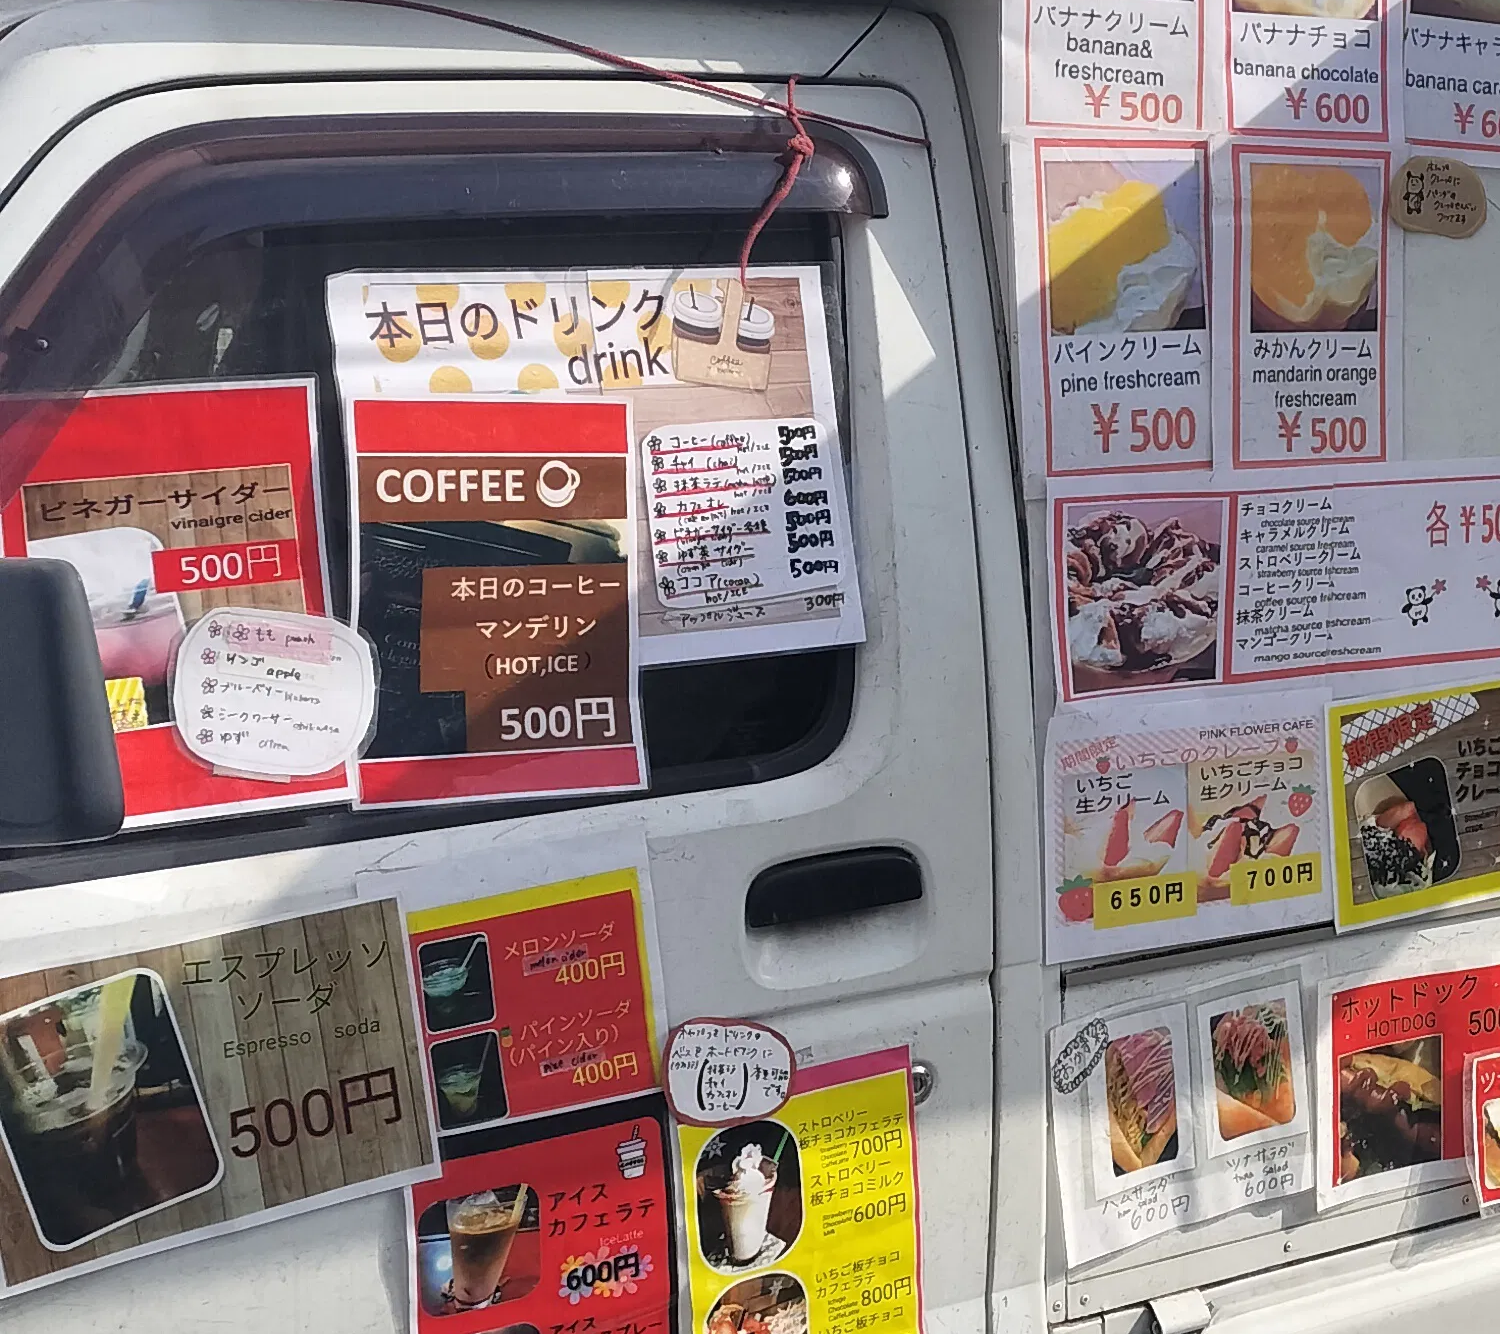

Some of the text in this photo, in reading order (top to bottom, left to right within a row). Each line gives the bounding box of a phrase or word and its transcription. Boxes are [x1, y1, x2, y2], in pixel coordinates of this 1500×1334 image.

[1034, 4, 1189, 38] バナナクリーム
[1067, 32, 1153, 59] banana&
[1240, 22, 1372, 50] バナナチョコ
[1055, 60, 1164, 88] freshcream
[1233, 59, 1379, 85] banana chocolate
[1406, 68, 1468, 94] banana
[365, 289, 668, 348] 本日のドリンク
[568, 338, 670, 385] drink
[1054, 336, 1201, 365] パインクリーム
[1254, 338, 1372, 360] みかんクリーム
[1061, 368, 1200, 397] pine freshcream
[1253, 365, 1377, 386] mandarin orange
[1275, 390, 1357, 407] freshcream
[376, 468, 525, 504] COFFEE
[40, 481, 290, 524] ビネガーサイダー
[249, 505, 294, 524] cider
[1241, 497, 1332, 517] チョコクリーム
[1240, 521, 1350, 543] キャラメルクリーム
[1261, 517, 1320, 528] chocolate source
[1425, 500, 1450, 548] 各
[1256, 542, 1315, 553] caramel source
[179, 543, 283, 585] 500円
[1257, 567, 1322, 578] strawberry source
[451, 573, 621, 602] 本日のコーヒー
[1255, 596, 1317, 608] coffee source
[474, 616, 597, 640] マンデリン
[1236, 603, 1314, 625] 抹茶クリーム
[1255, 619, 1322, 636] matcha source
[255, 628, 276, 642] もも
[1254, 652, 1290, 663] mango
[266, 667, 301, 680] apple
[500, 696, 617, 742] 500円
[1200, 719, 1314, 740] PINK FLOWER CAFE
[1345, 700, 1437, 771] 期間限定
[1060, 736, 1119, 770] 期間限定
[1116, 737, 1279, 771] いちごのクレープ
[1076, 773, 1133, 793] いちご
[1201, 757, 1303, 780] いちごチョコ
[1076, 790, 1170, 815] 生クリーム
[1201, 778, 1287, 801] 生クリーム
[1247, 862, 1314, 890] 700円
[1110, 881, 1184, 911] 650円
[504, 921, 615, 960] メロンソーダ
[182, 940, 391, 987] エスプレッソ
[555, 951, 625, 985] 400円
[237, 981, 337, 1022] ソーダ
[1340, 974, 1480, 1024] ホットドック
[521, 999, 631, 1041] パインソーダ
[1366, 1011, 1437, 1041] HOTDOG
[223, 1018, 382, 1059] Espresso soda
[572, 1052, 638, 1086] 400円
[230, 1067, 402, 1159] 500円
[799, 1110, 868, 1135] ストロベリー
[799, 1113, 904, 1151] 板チョコカフェラテ
[849, 1128, 903, 1159] 700円
[810, 1171, 904, 1206] 板チョコミルク
[811, 1160, 891, 1188] ストロベリー
[1245, 1174, 1294, 1197] 600円
[548, 1183, 608, 1212] アイス
[854, 1192, 906, 1223] 600円
[548, 1199, 655, 1238] カフェラテ
[1131, 1195, 1190, 1230] 600円
[600, 1229, 644, 1247] IceLatte
[566, 1251, 640, 1291] 600円
[815, 1251, 900, 1283] いちご板チョコ
[816, 1272, 876, 1299] カフェラテ
[861, 1276, 912, 1307] 800円
